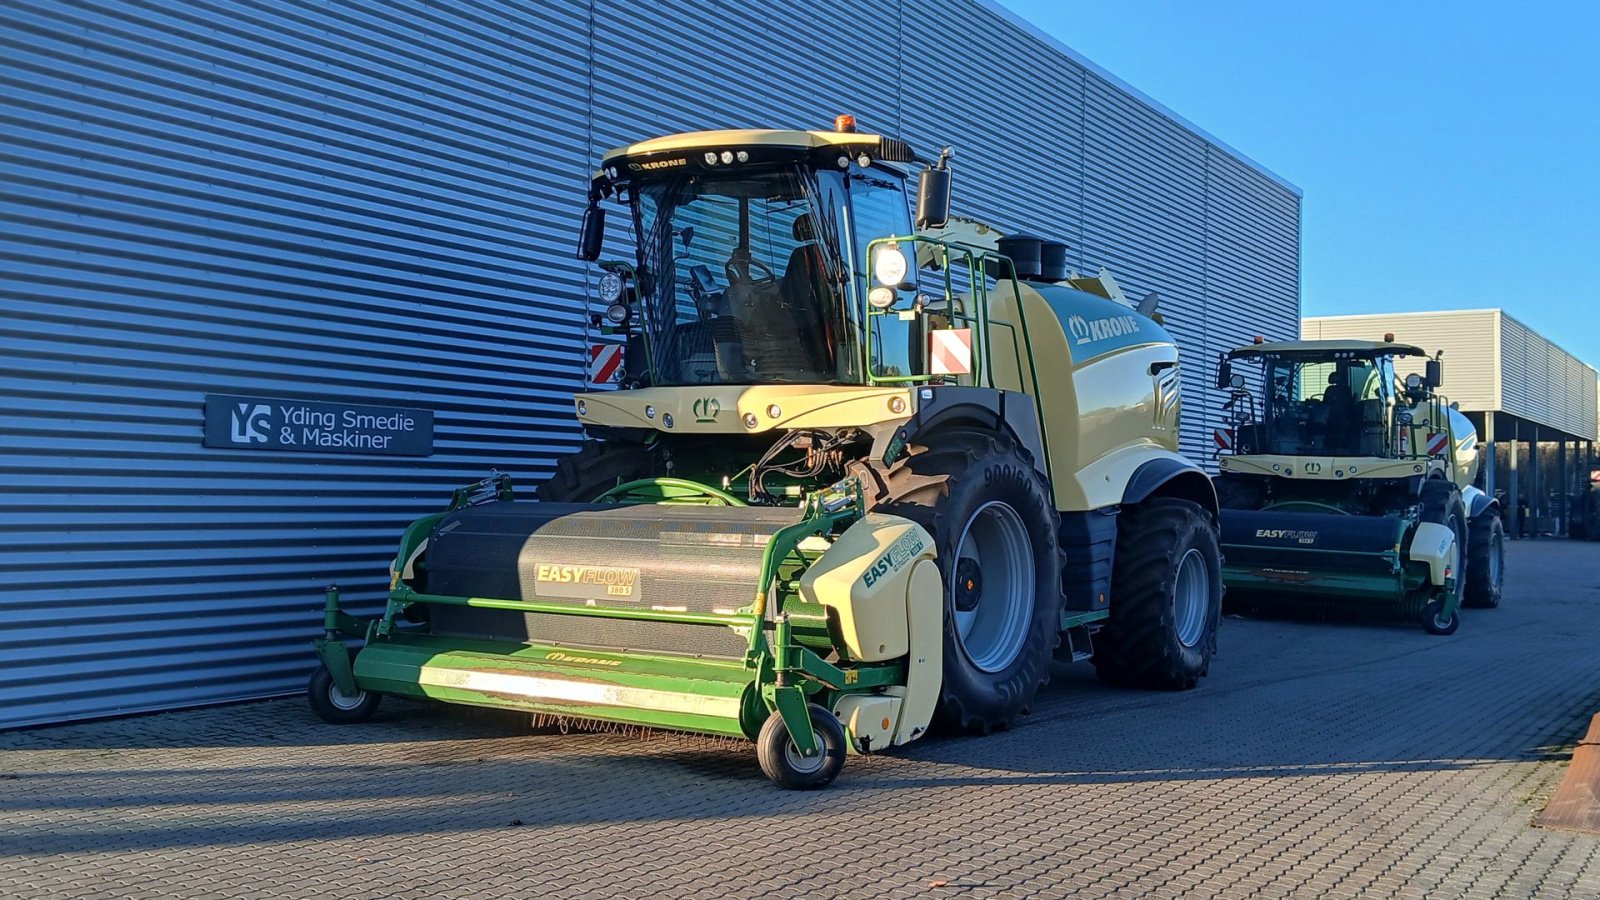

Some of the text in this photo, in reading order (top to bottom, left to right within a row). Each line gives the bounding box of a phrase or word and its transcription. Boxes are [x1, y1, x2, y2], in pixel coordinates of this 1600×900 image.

[641, 158, 687, 169] KRONE
[1089, 315, 1140, 341] KRONE
[279, 405, 415, 432] Yding Smedie
[279, 426, 393, 449] & Maskiner
[863, 528, 921, 588] EASYFLOW
[537, 565, 637, 586] EASYFLOW
